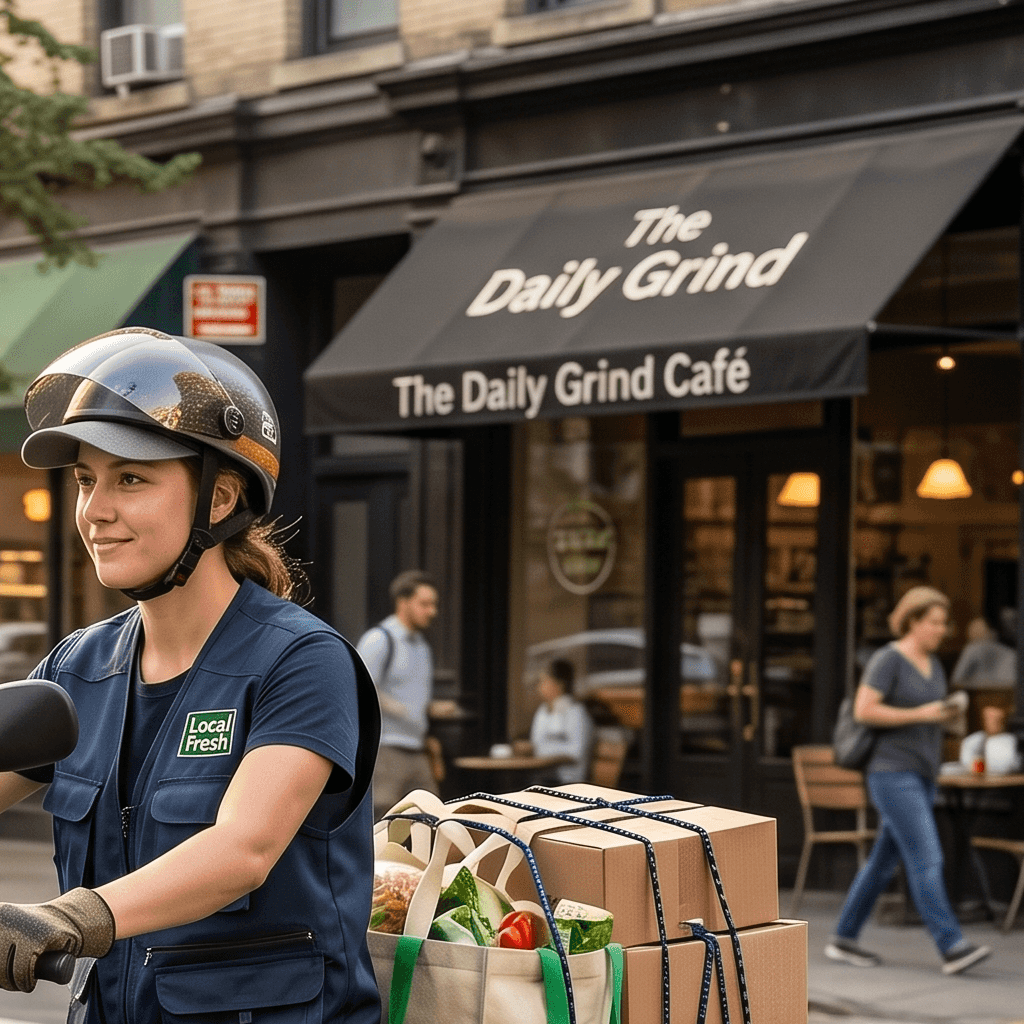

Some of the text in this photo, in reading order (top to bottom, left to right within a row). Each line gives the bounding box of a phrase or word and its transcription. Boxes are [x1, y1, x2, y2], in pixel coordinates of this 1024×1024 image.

[625, 205, 713, 249] The
[465, 231, 810, 319] Daily Grind
[392, 346, 752, 420] The Daily Grind Café
[185, 733, 229, 752] Fresh
[189, 713, 233, 734] Local
